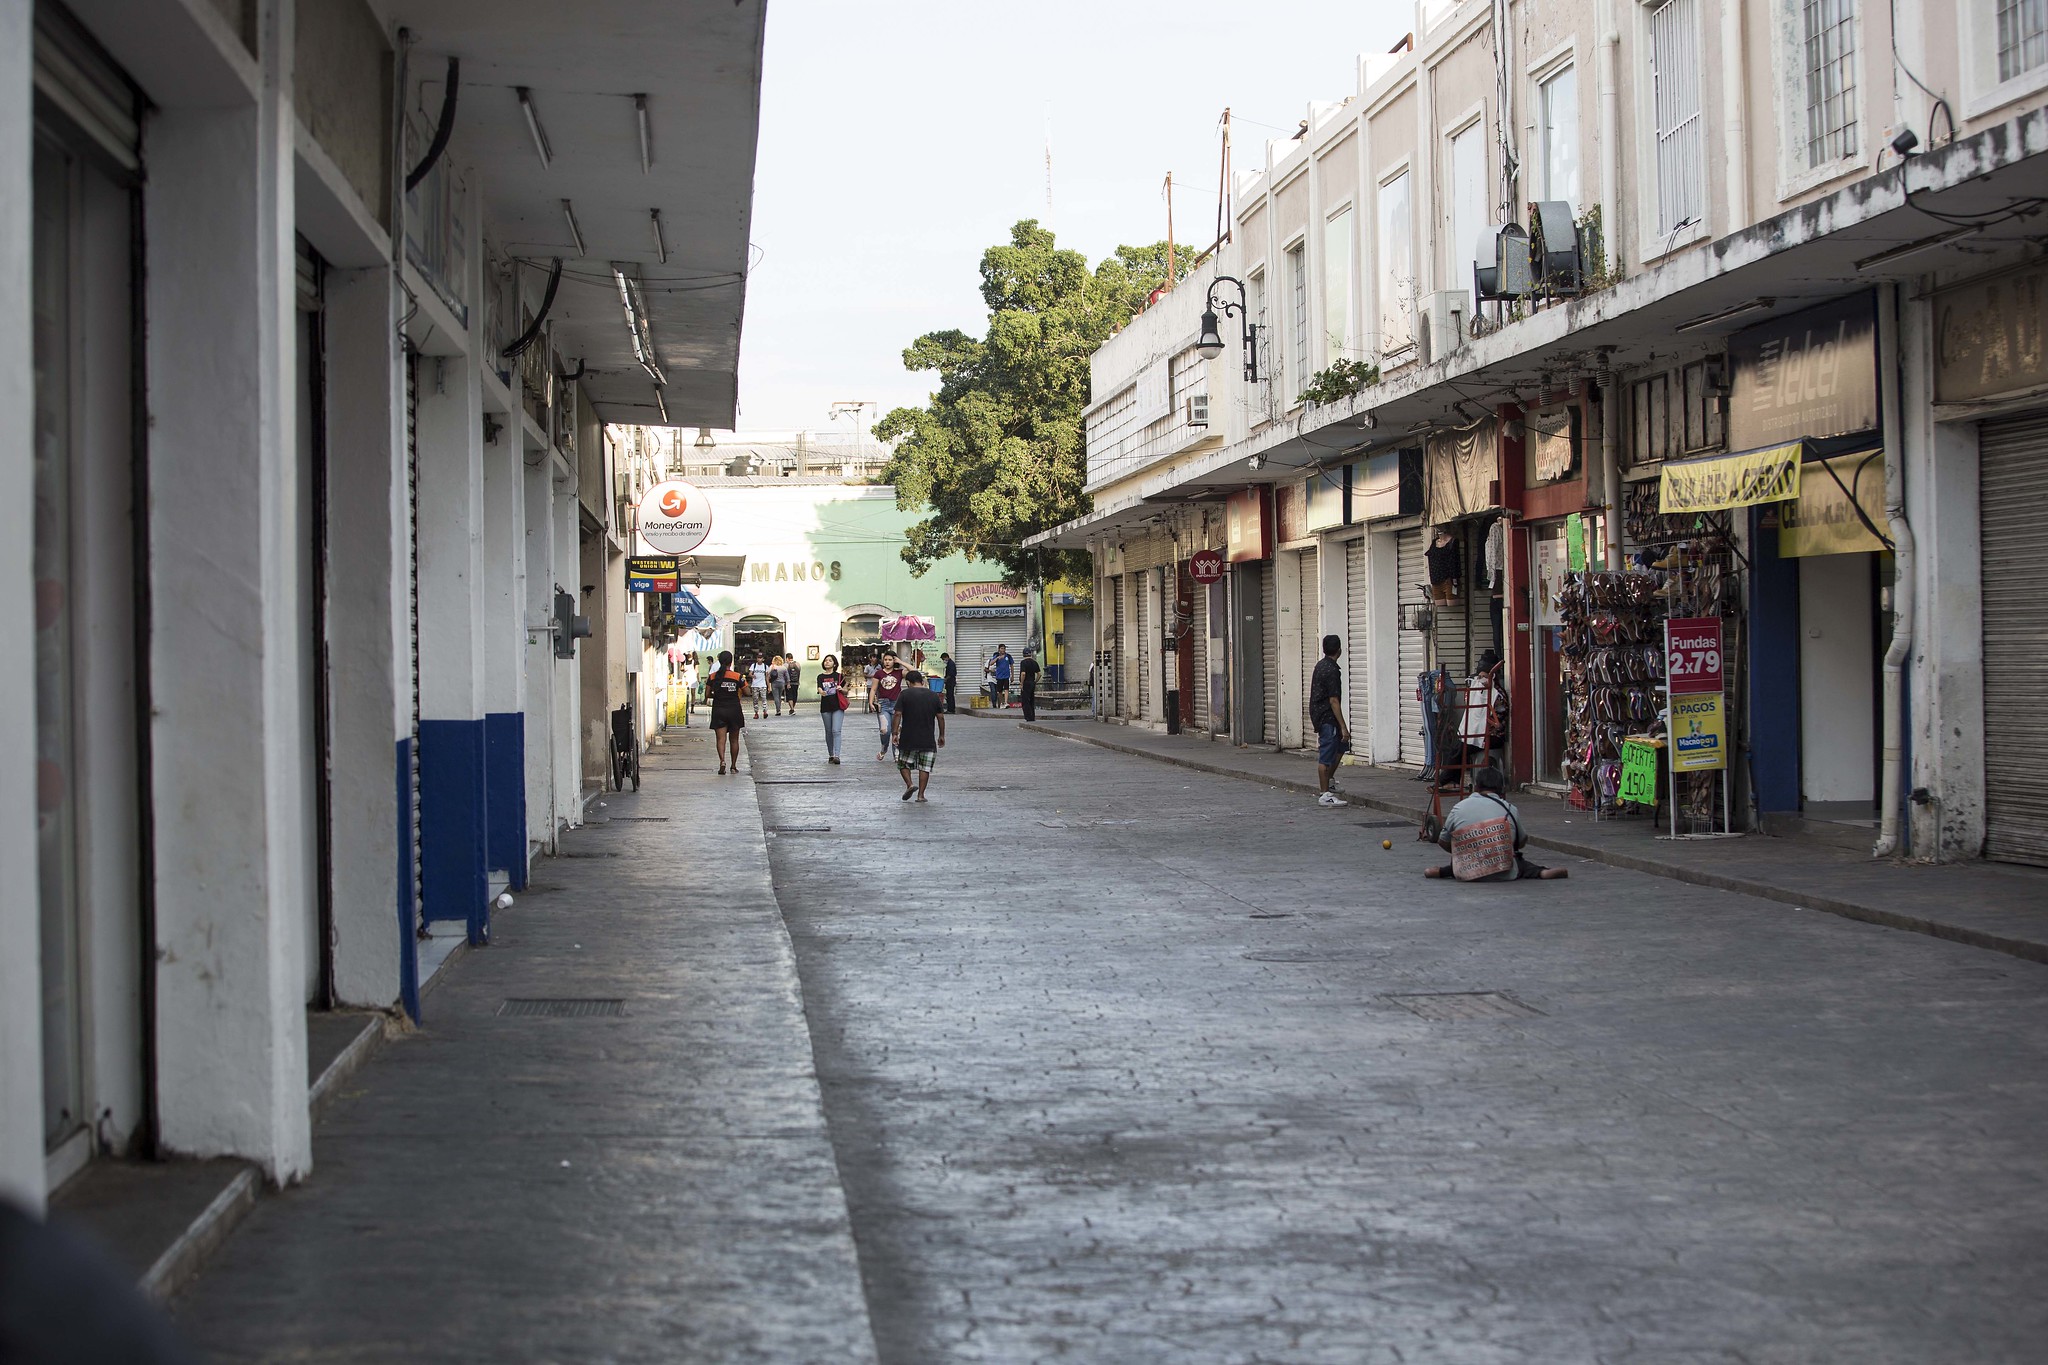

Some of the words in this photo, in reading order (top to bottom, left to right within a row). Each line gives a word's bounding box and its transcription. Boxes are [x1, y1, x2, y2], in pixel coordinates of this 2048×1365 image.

[1776, 320, 1846, 408] telcel
[1801, 403, 1838, 422] AUTORIZADO
[644, 520, 703, 531] MoneyGram
[742, 561, 841, 582] MANOS
[634, 581, 650, 589] vigo
[956, 585, 982, 602] BAZAR
[1671, 635, 1717, 650] Fundas
[1670, 650, 1720, 675] 2x79
[1673, 706, 1679, 715] A
[1680, 702, 1716, 714] PAGOS
[1625, 771, 1646, 797] 150
[1485, 823, 1505, 835] para
[1467, 832, 1510, 849] operación
